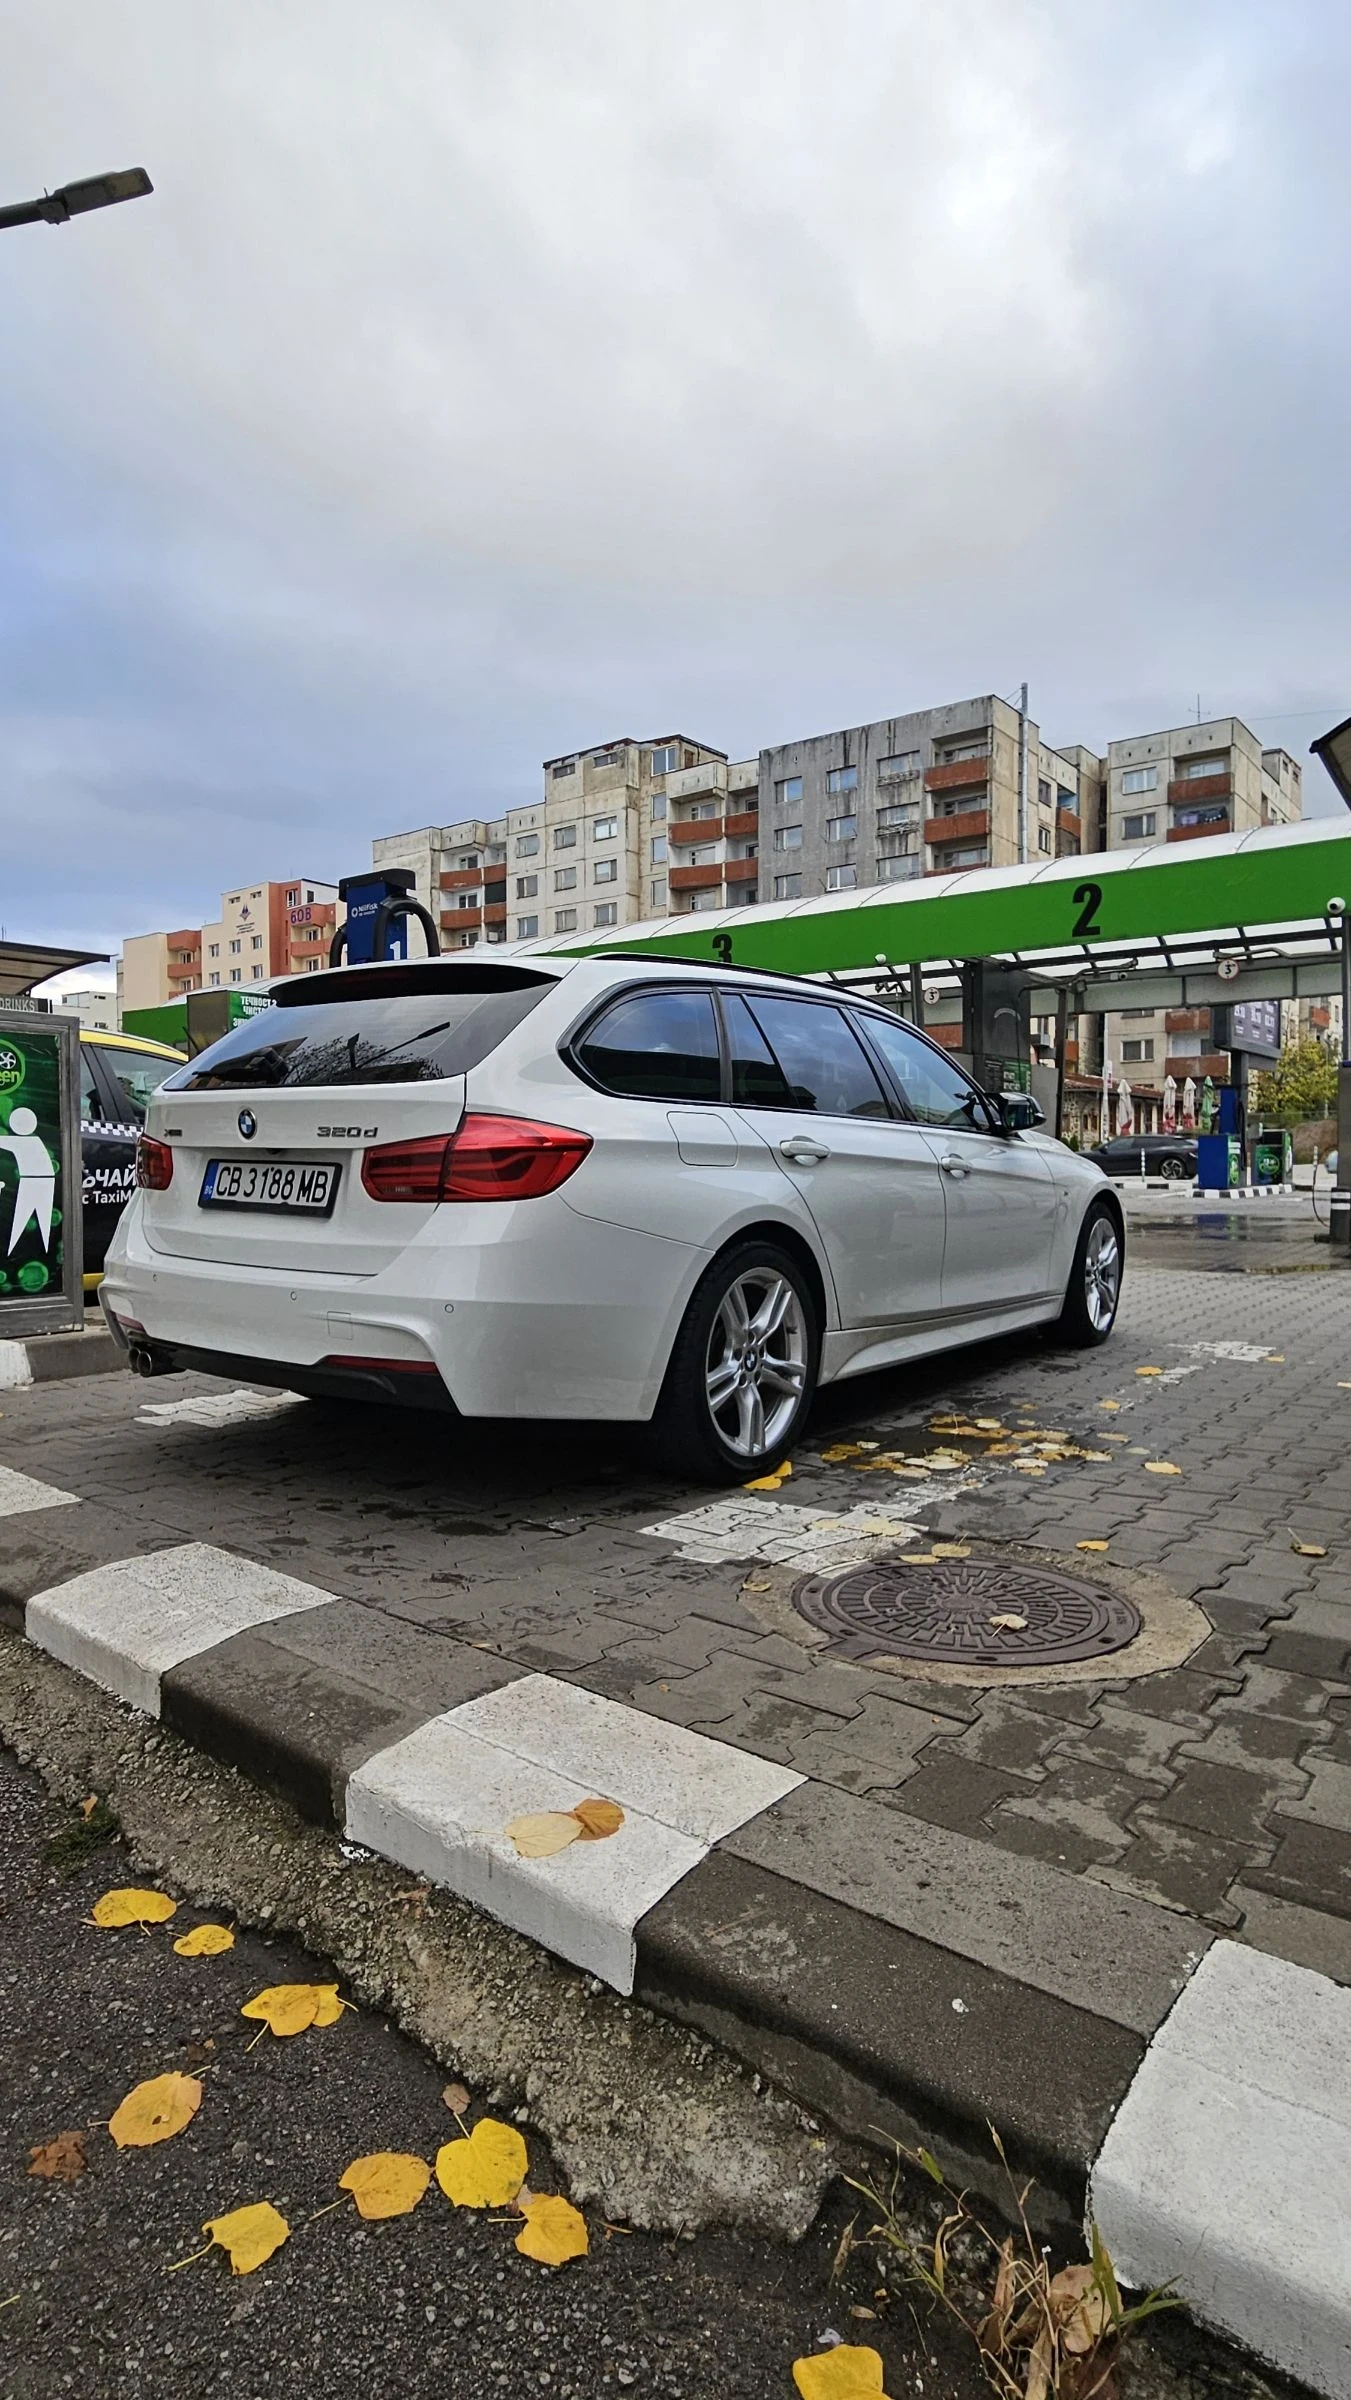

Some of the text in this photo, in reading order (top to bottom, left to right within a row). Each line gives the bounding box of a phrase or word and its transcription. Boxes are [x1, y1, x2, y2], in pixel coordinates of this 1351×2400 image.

[1072, 882, 1102, 937] 2
[389, 940, 401, 961] 1
[712, 933, 732, 963] 3
[0, 997, 36, 1012] DRINKS
[317, 1126, 378, 1138] 320d
[243, 1167, 295, 1201] 3188
